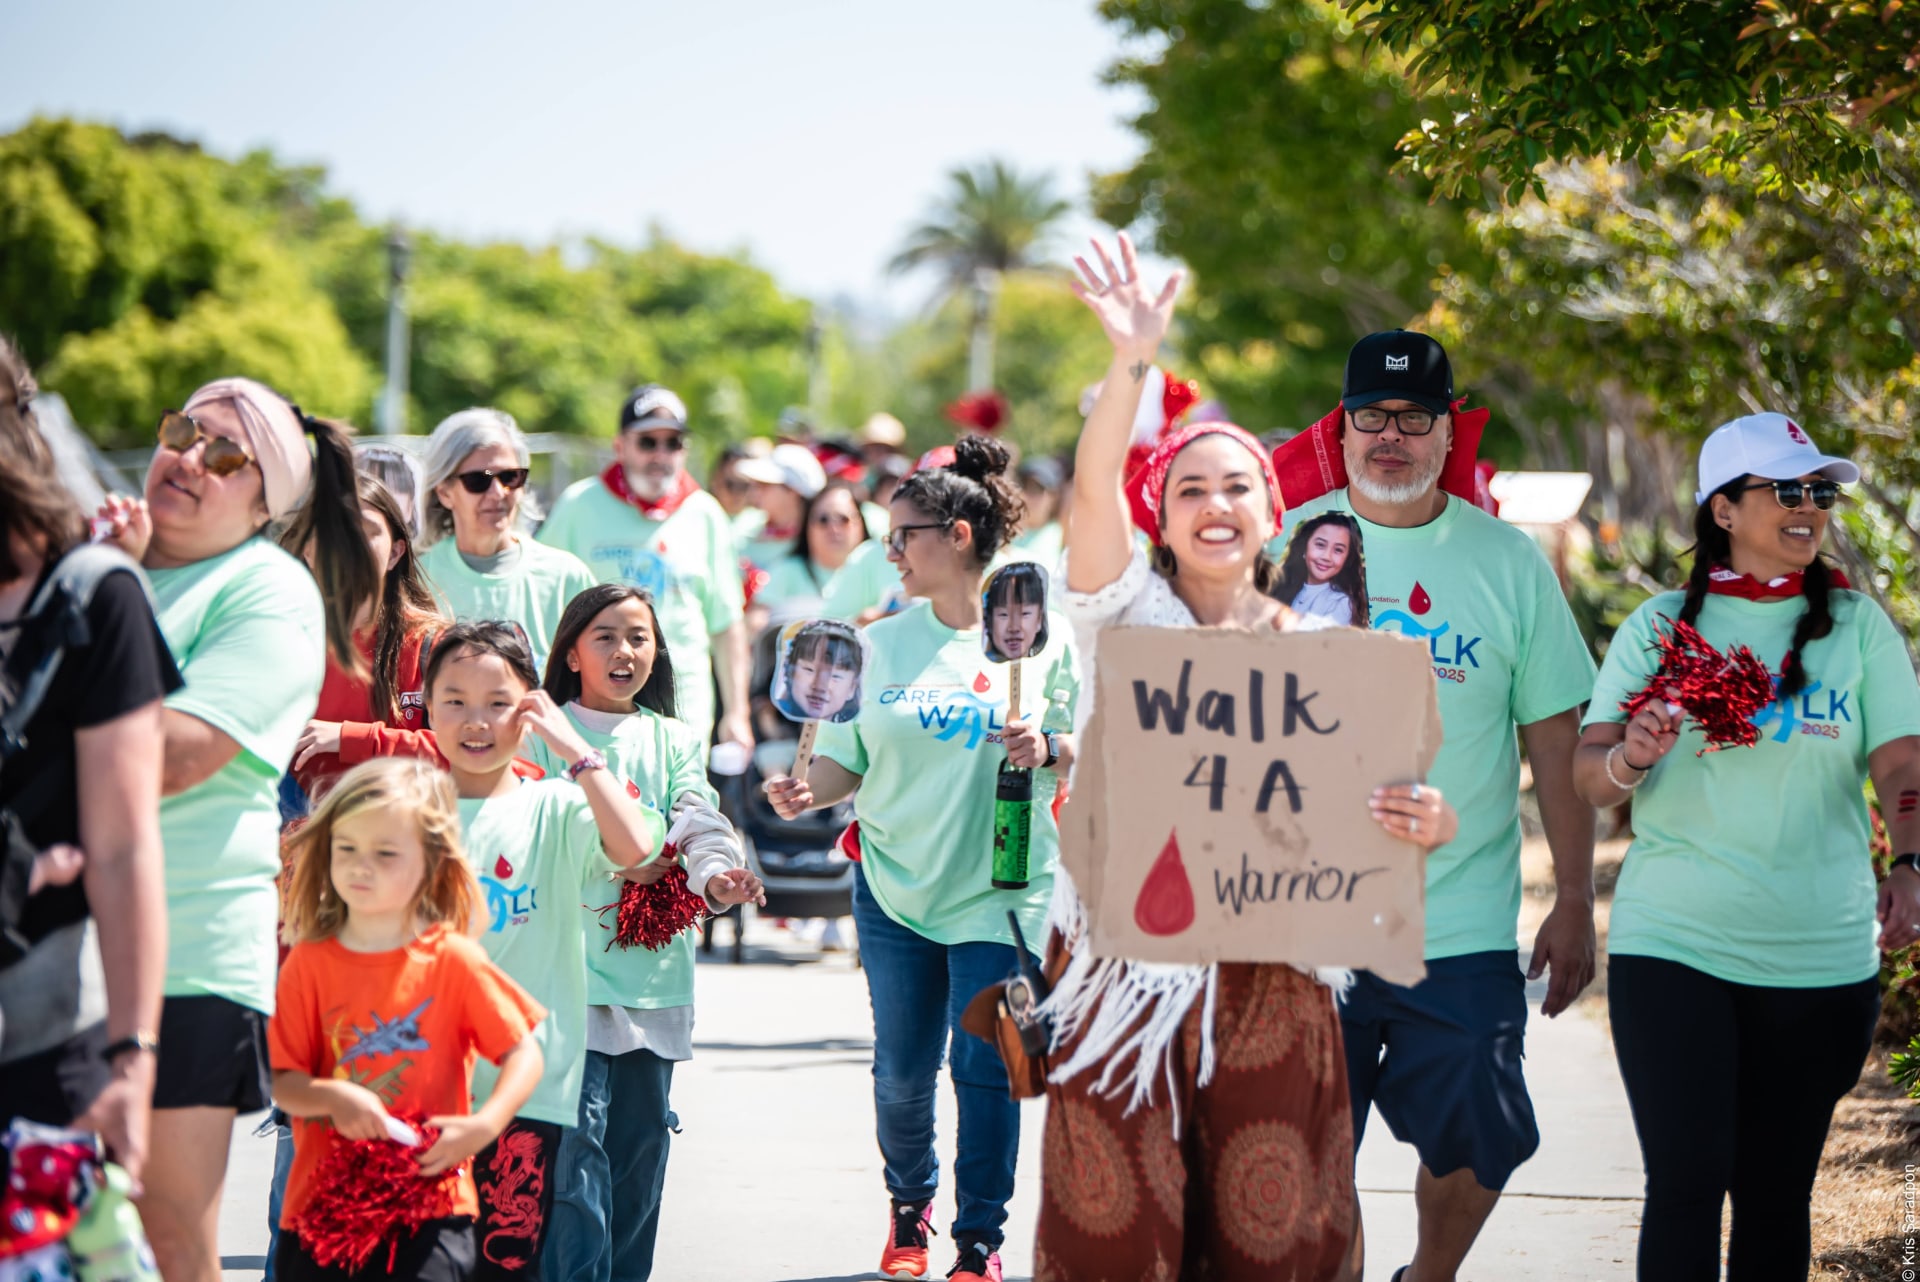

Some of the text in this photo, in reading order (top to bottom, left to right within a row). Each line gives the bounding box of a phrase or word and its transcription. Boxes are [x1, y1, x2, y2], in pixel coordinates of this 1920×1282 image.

[879, 689, 941, 704] CARE
[1132, 659, 1340, 743] Walk
[918, 702, 1032, 750] WAL
[985, 732, 1004, 745] 20
[1800, 722, 1840, 740] 2025
[1183, 755, 1308, 813] 4 A
